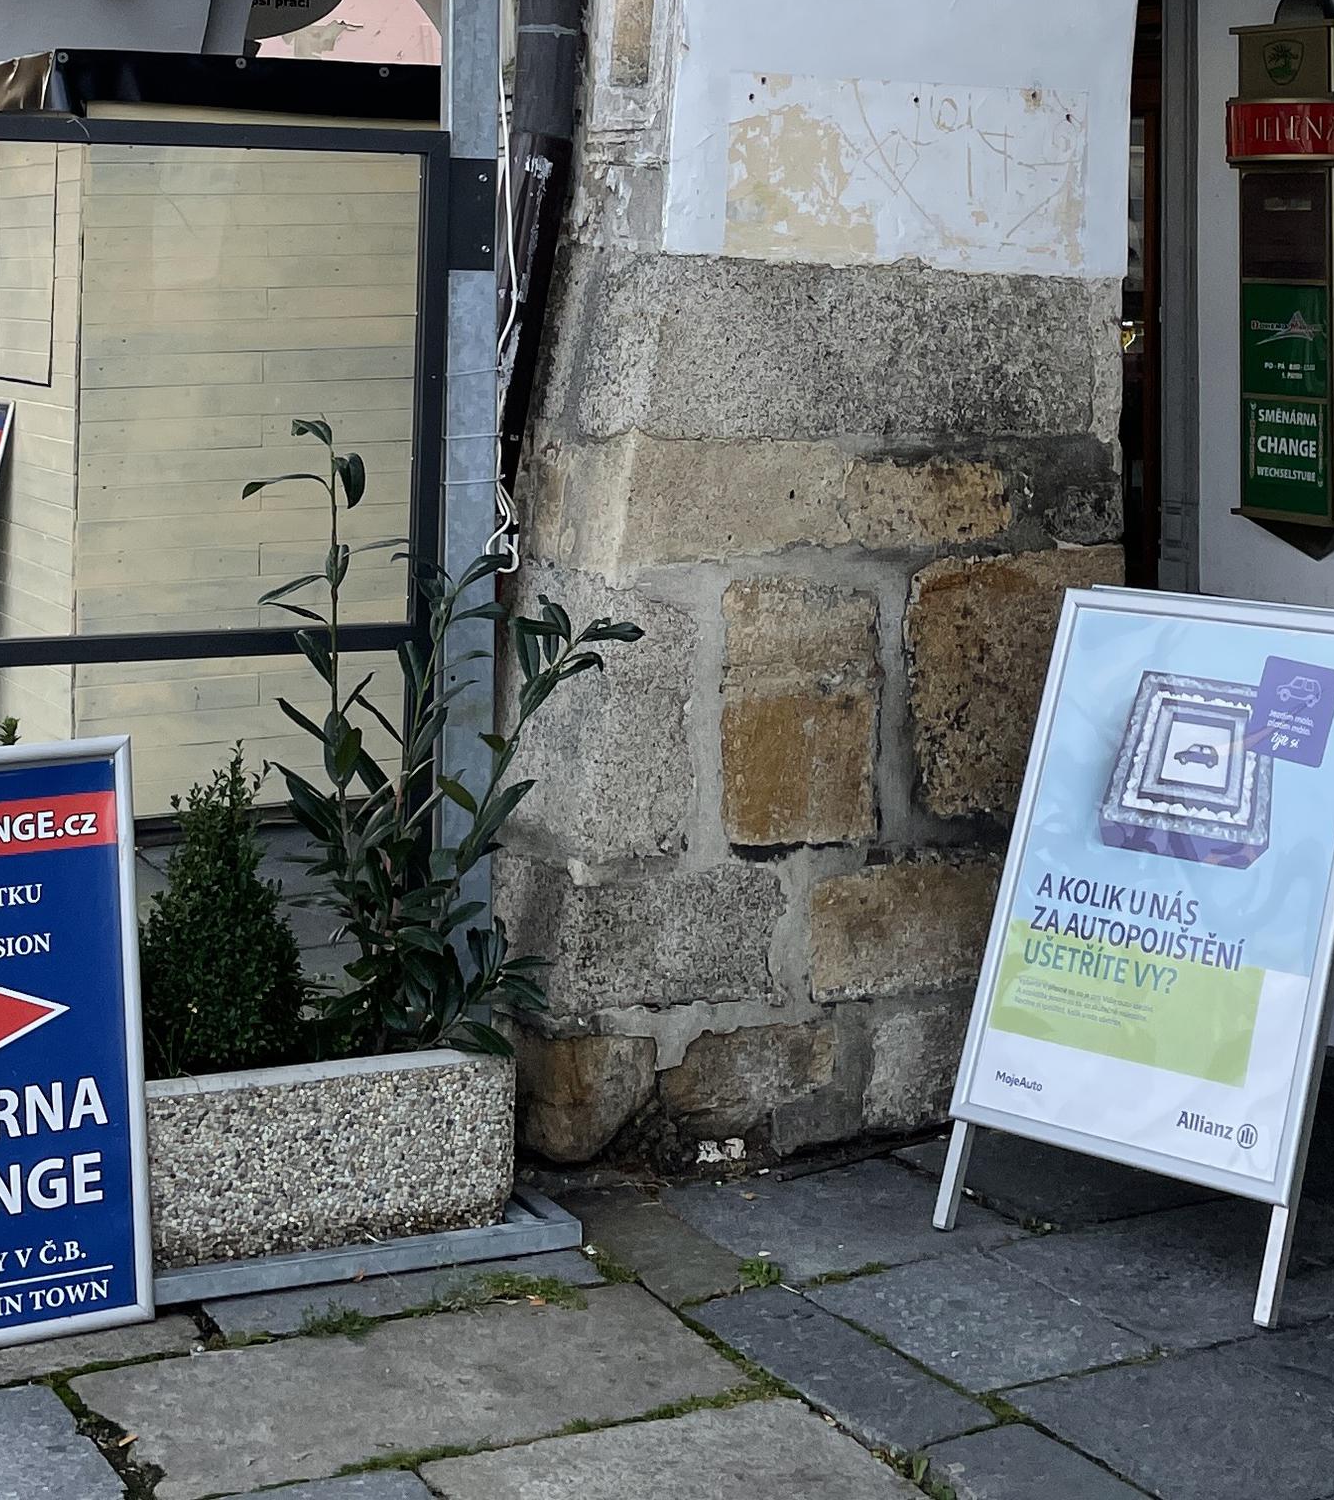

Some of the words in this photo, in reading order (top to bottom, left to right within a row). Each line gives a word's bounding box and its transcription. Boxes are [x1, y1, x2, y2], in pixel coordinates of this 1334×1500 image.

[1258, 407, 1317, 427] SMĚNÁRNA
[1257, 435, 1317, 459] CHANGE
[1036, 873, 1052, 899] A
[1058, 876, 1126, 912] KOLIK
[1129, 891, 1146, 915] U
[1149, 891, 1199, 926] NÁS
[1030, 905, 1059, 934] ZA
[1063, 912, 1246, 972] AUTOPOJIŠTĚNÍ
[1024, 935, 1129, 984] UŠETŘÍTE
[1135, 961, 1178, 994] VY?
[995, 1070, 1043, 1093] MojeAuto
[1176, 1110, 1234, 1142] Allianz
[14, 1248, 32, 1269] V
[39, 1238, 88, 1266] Č.B.
[31, 1279, 109, 1313] TOWN
